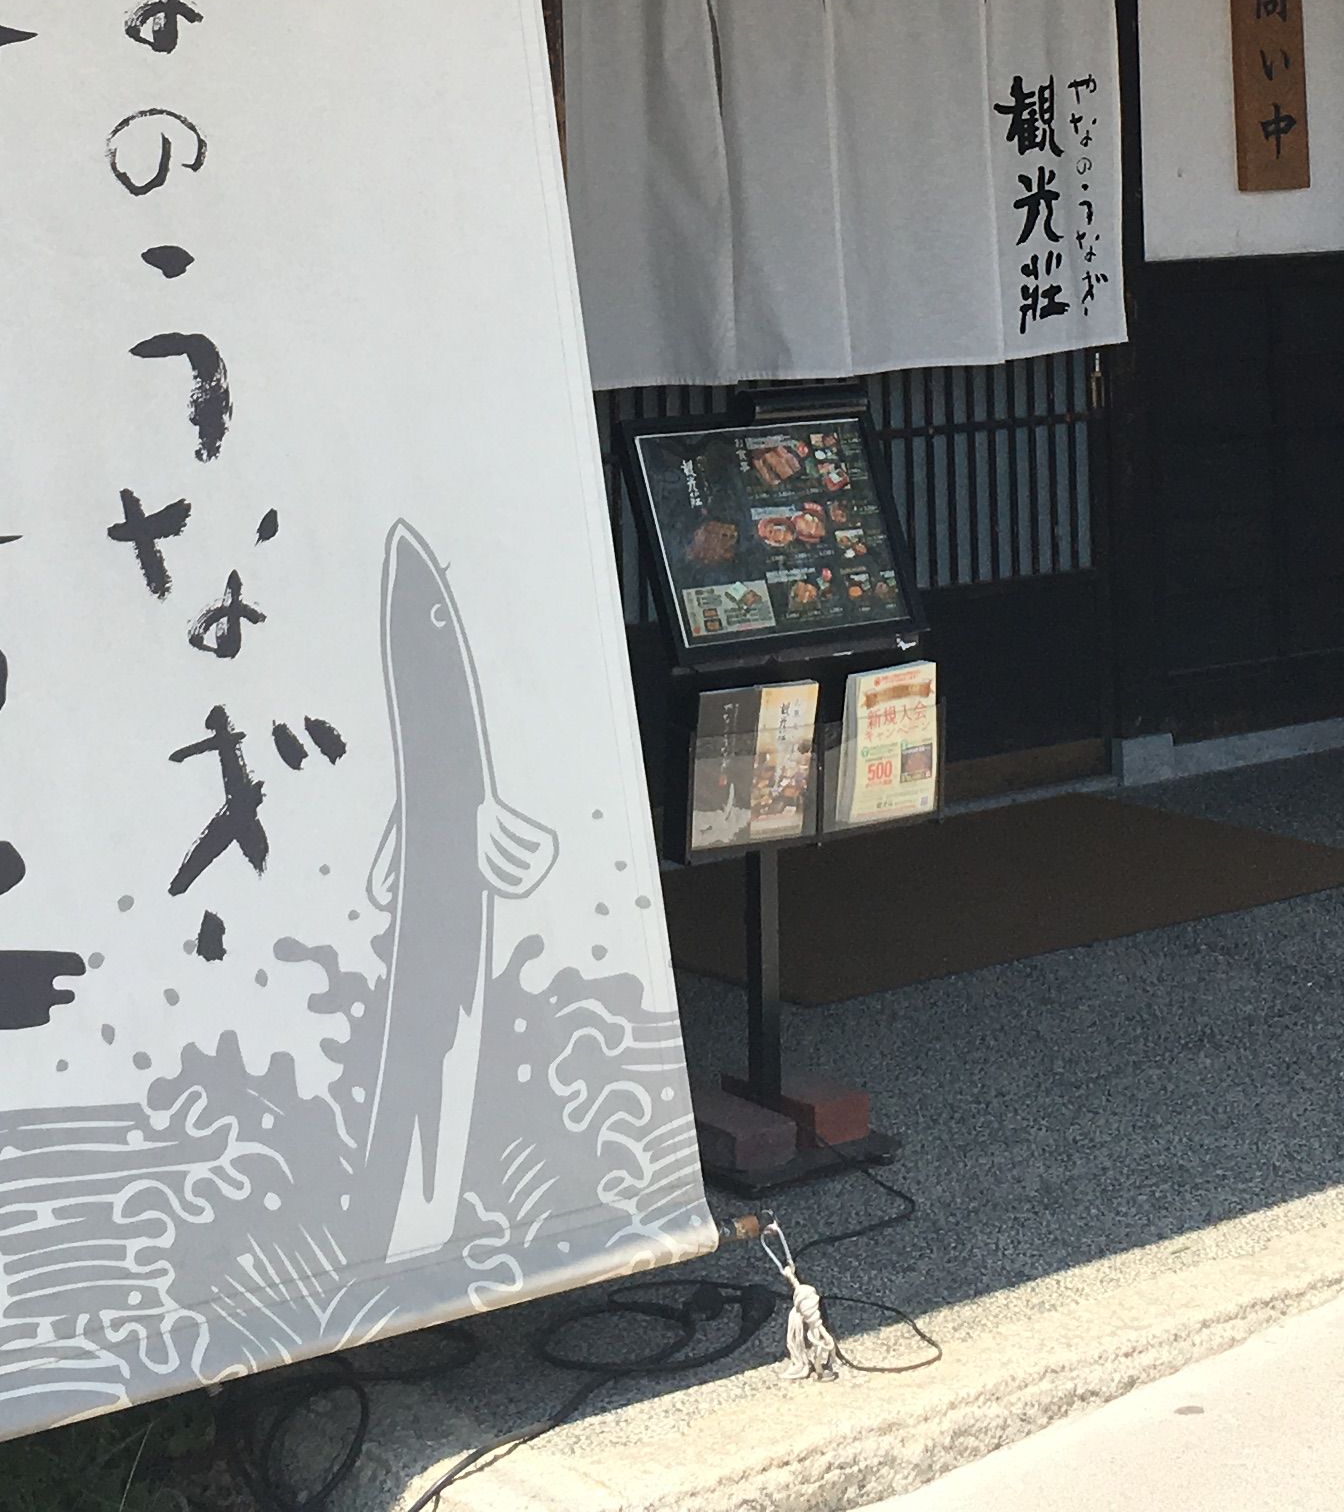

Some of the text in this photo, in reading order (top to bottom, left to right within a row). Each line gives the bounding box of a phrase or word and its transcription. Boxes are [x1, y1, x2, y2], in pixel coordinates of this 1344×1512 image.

[1067, 73, 1108, 317] やなのうなぎ
[867, 700, 928, 730] 新規入会
[867, 760, 893, 781] 500
